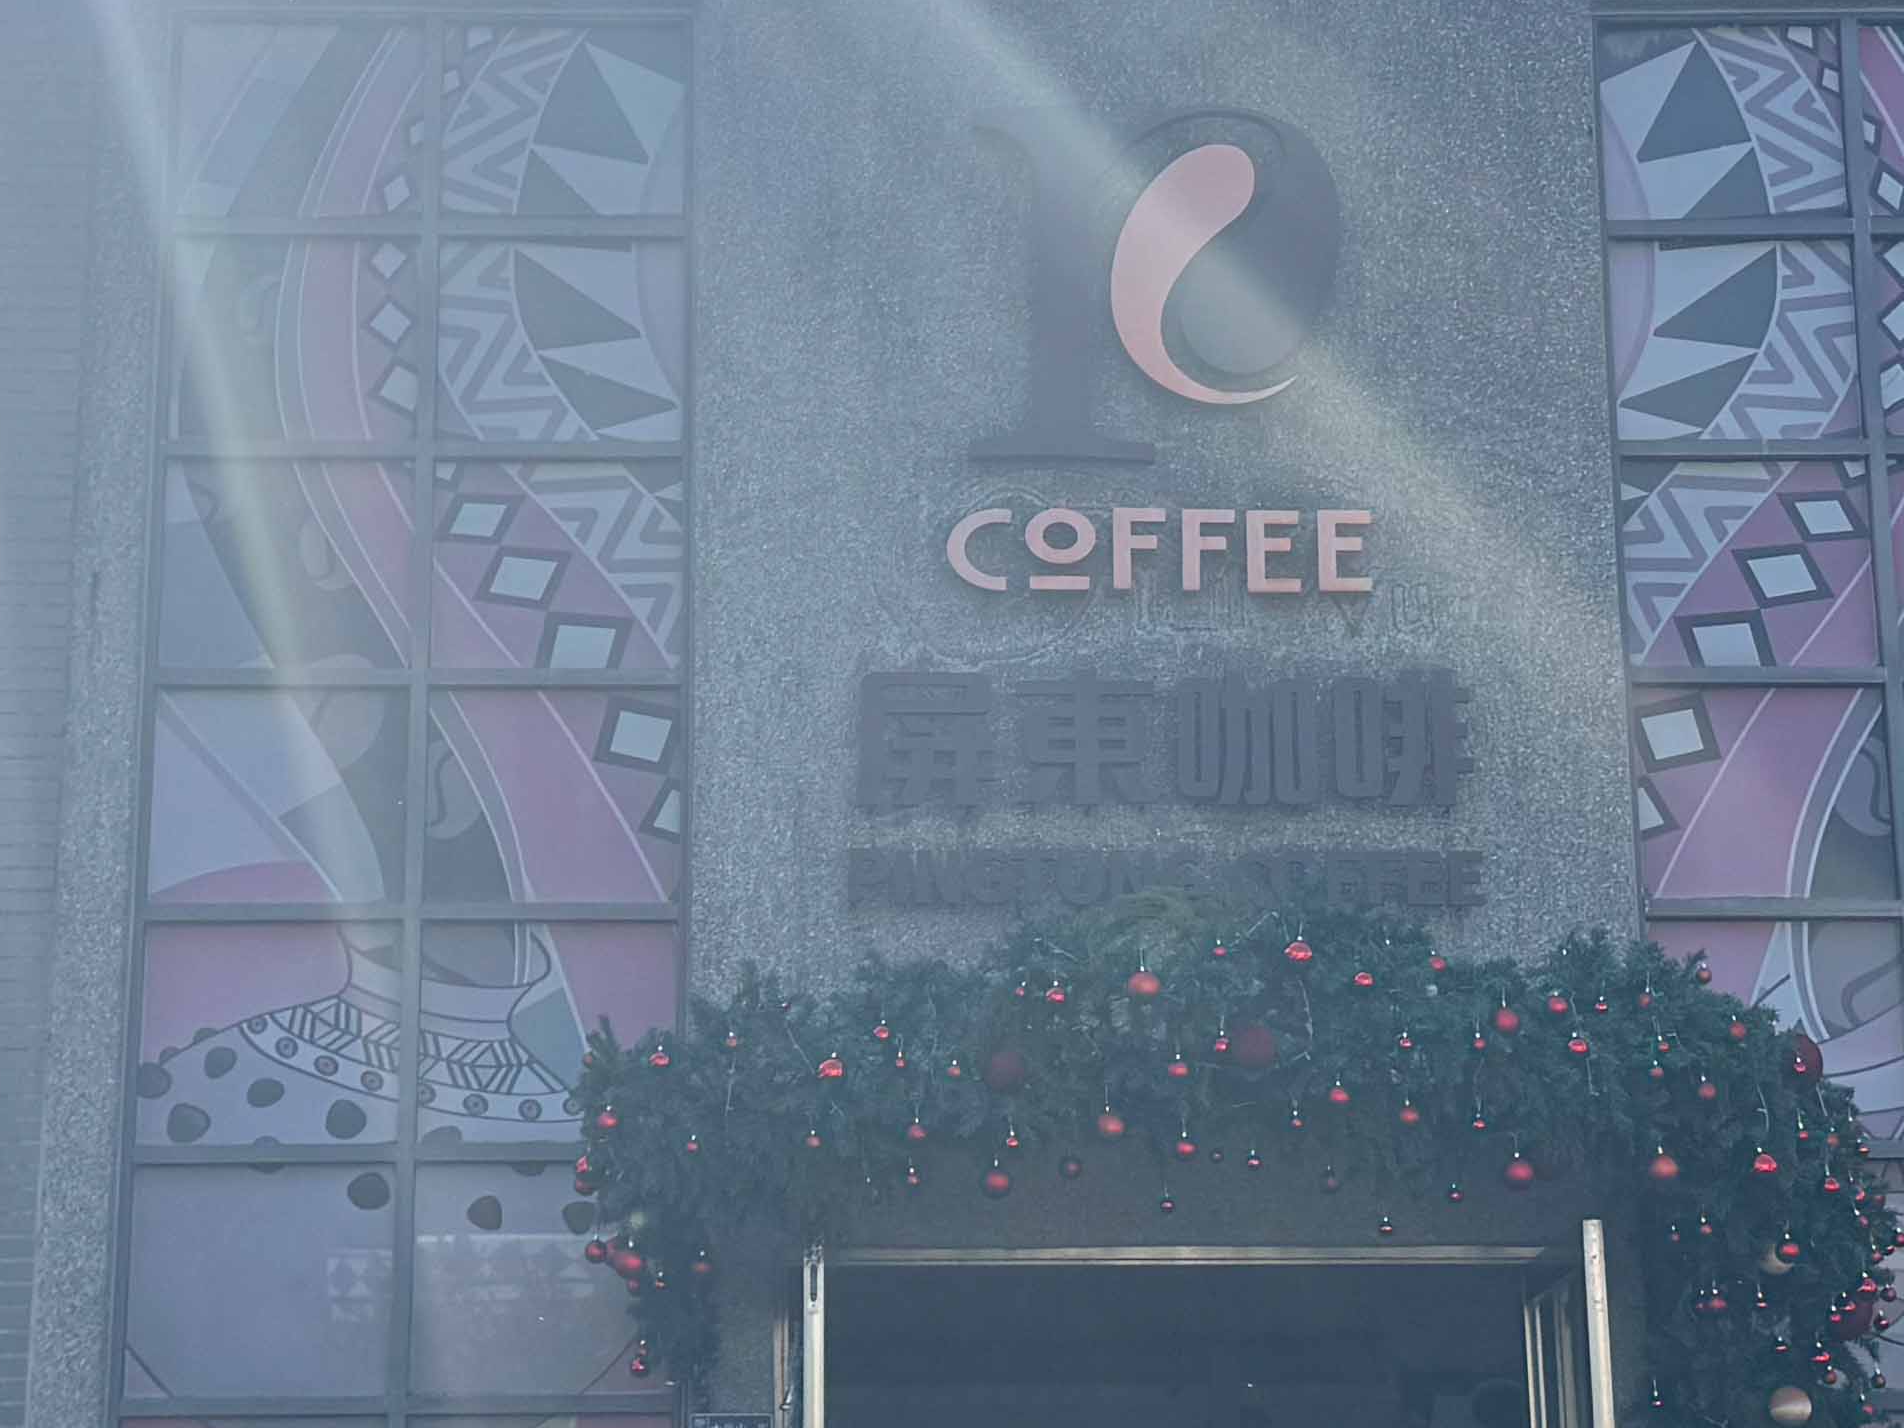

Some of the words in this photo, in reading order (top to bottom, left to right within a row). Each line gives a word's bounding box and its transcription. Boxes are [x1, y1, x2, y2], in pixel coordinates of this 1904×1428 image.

[946, 508, 1373, 594] COFFEE
[856, 669, 1472, 806] 屏東咖啡
